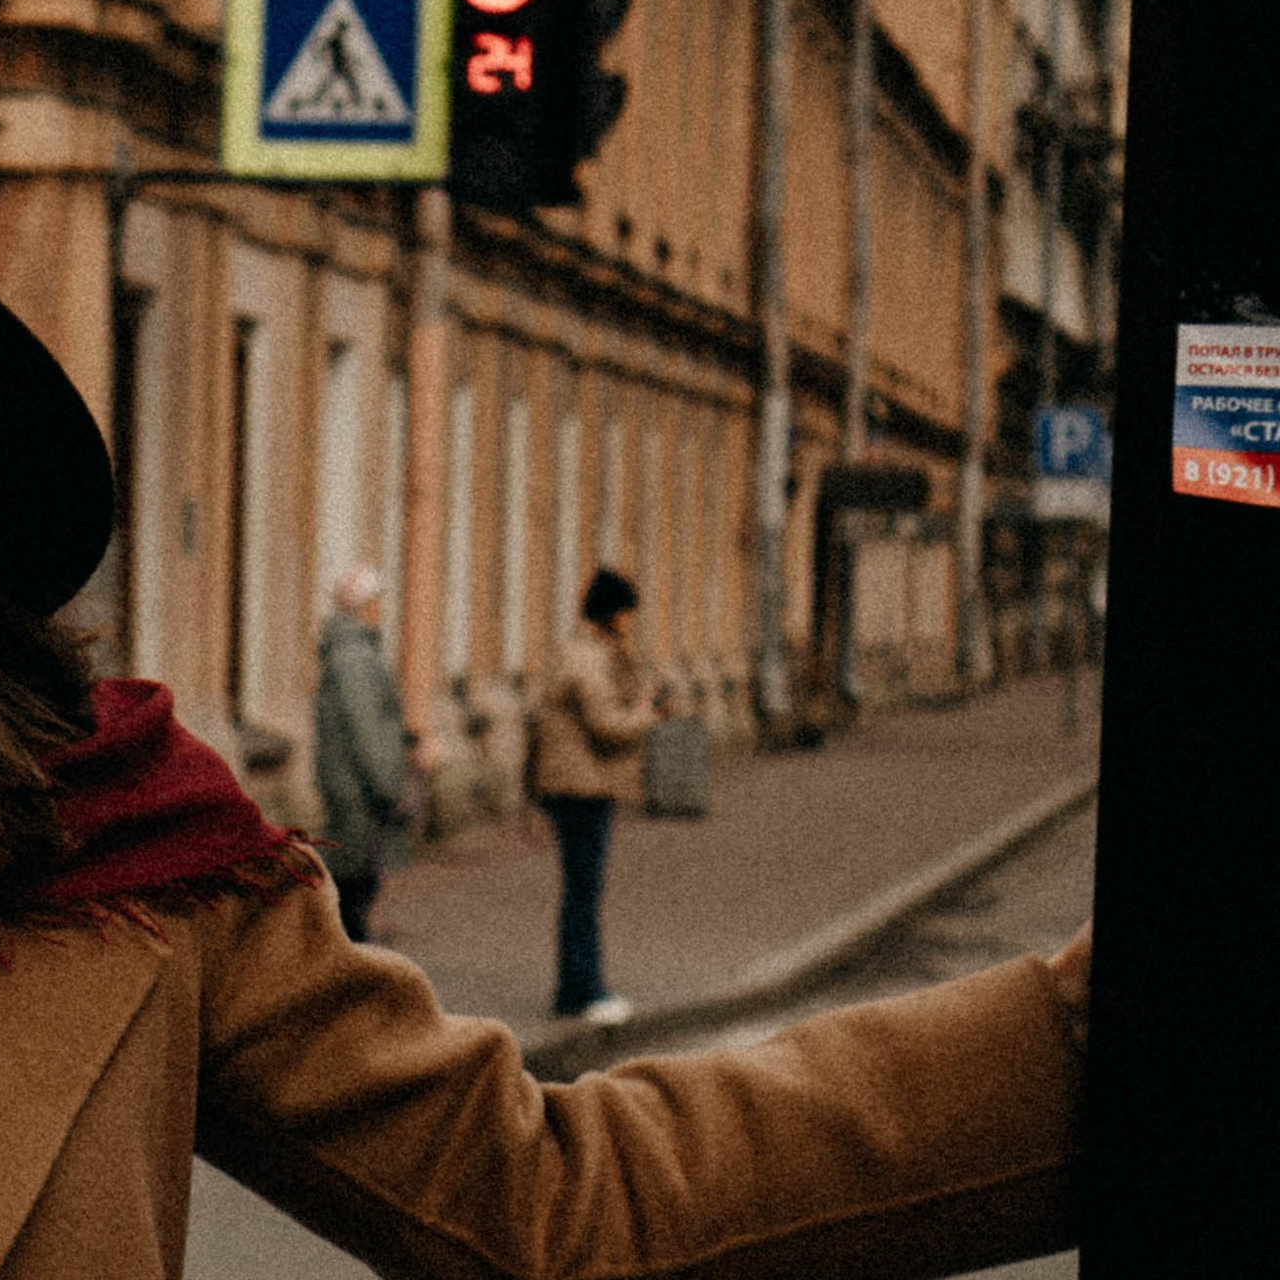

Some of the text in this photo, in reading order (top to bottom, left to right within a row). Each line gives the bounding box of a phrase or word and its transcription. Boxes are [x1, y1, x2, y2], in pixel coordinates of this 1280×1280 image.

[466, 31, 534, 95] 24
[1188, 344, 1242, 358] ПОПАЛ
[1244, 345, 1254, 359] В
[1187, 362, 1280, 377] ОСТАЛСЯ БЕЗ
[1192, 395, 1274, 413] РАБОЧЕЕ
[1184, 459, 1275, 493] 8 (921)
